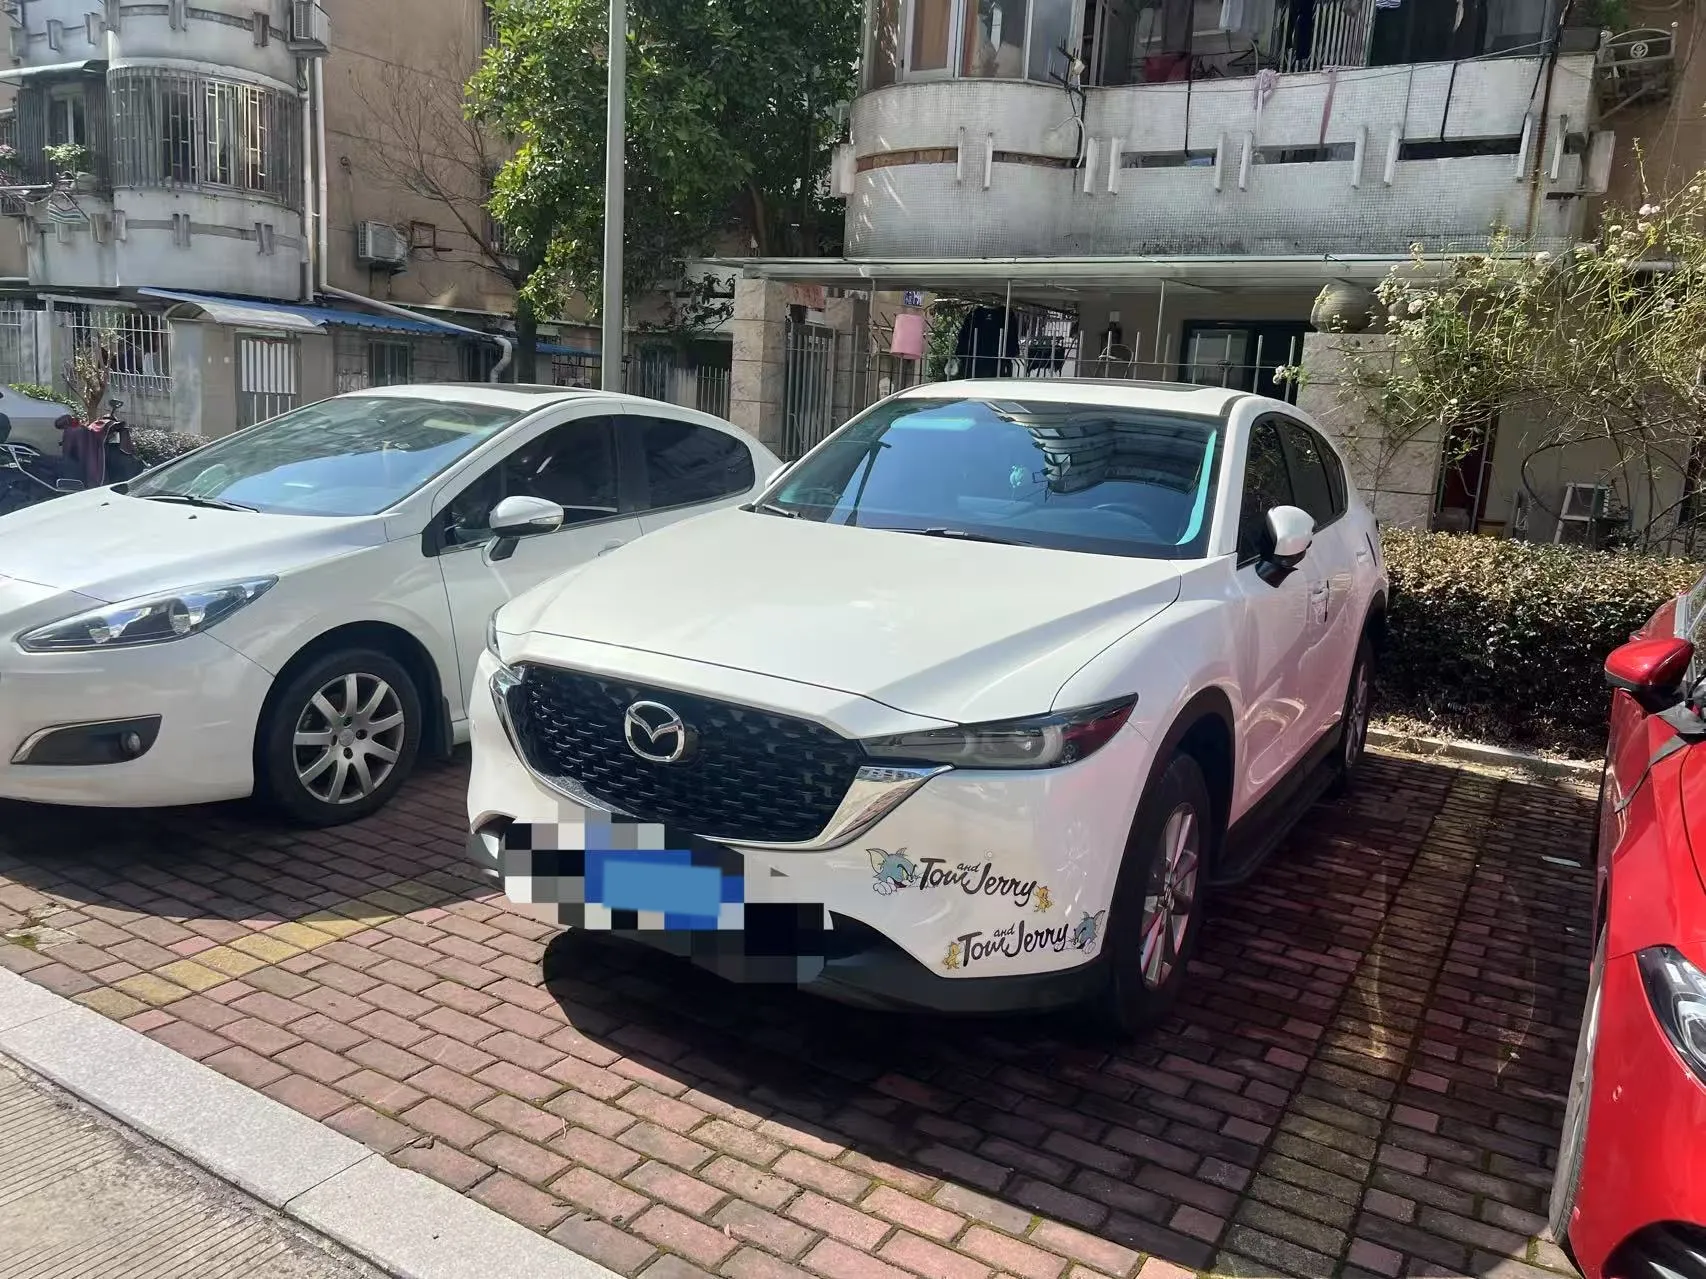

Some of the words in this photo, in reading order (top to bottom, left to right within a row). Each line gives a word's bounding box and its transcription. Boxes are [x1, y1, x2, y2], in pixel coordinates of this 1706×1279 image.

[957, 862, 981, 873] and
[963, 862, 1037, 907] Jerry
[994, 923, 1015, 938] and
[1003, 920, 1069, 957] Jerry
